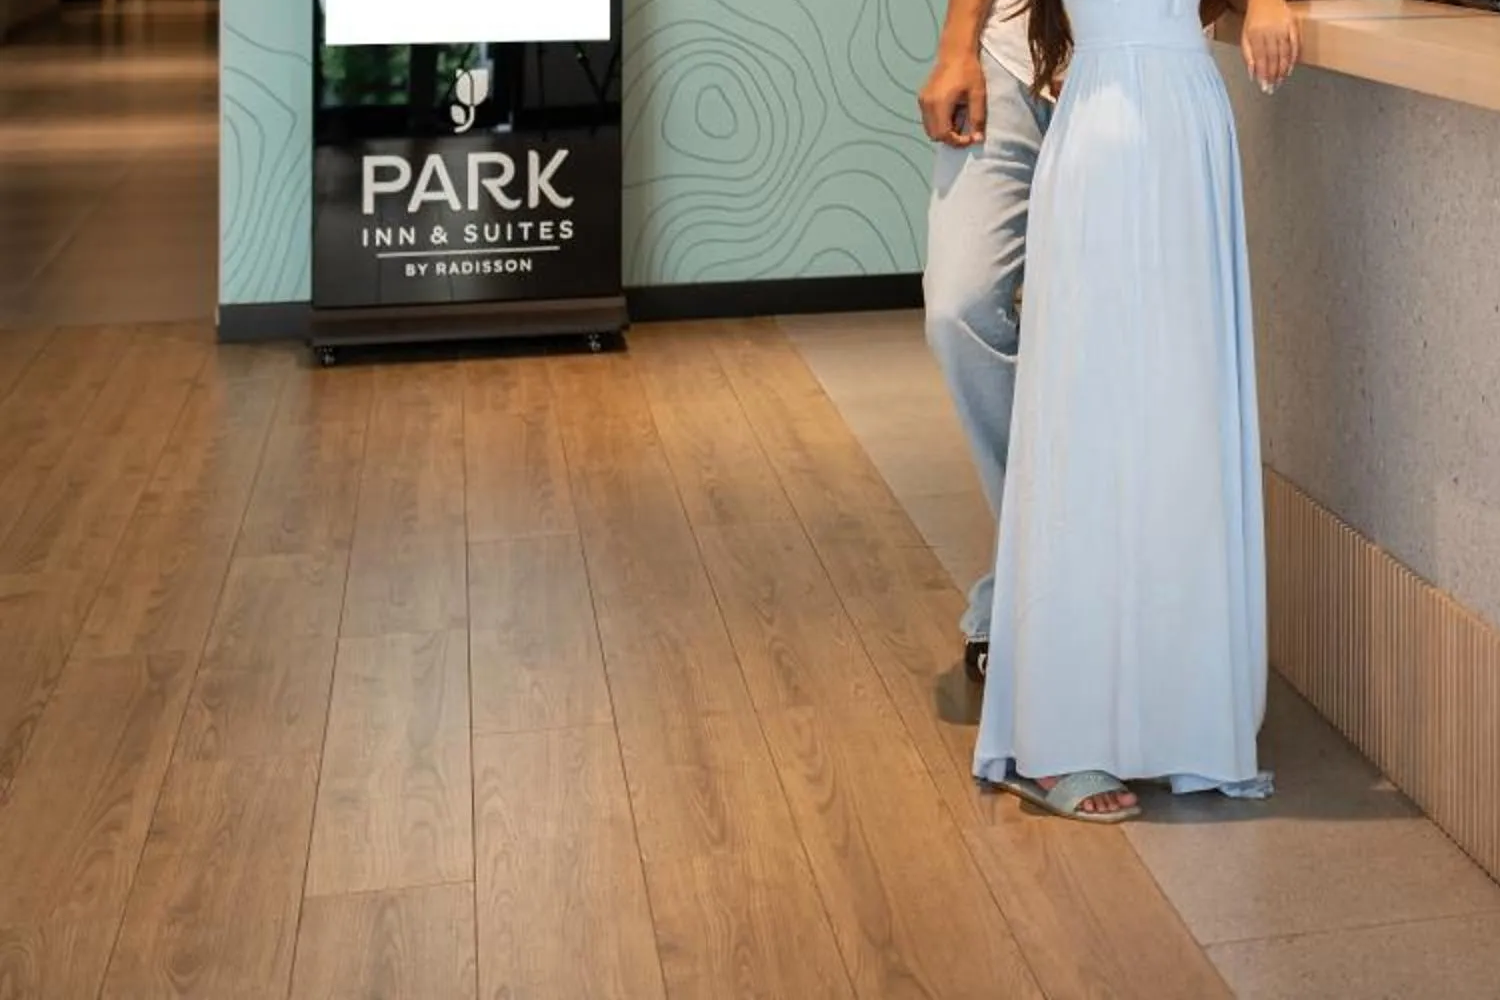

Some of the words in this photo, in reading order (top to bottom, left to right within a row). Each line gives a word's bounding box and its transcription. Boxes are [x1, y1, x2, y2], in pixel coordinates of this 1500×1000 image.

[362, 149, 574, 215] PARK
[362, 226, 416, 247] INN
[430, 225, 448, 245] &
[464, 220, 574, 243] SUITES
[405, 263, 428, 276] BY
[436, 258, 533, 275] RADISSON
